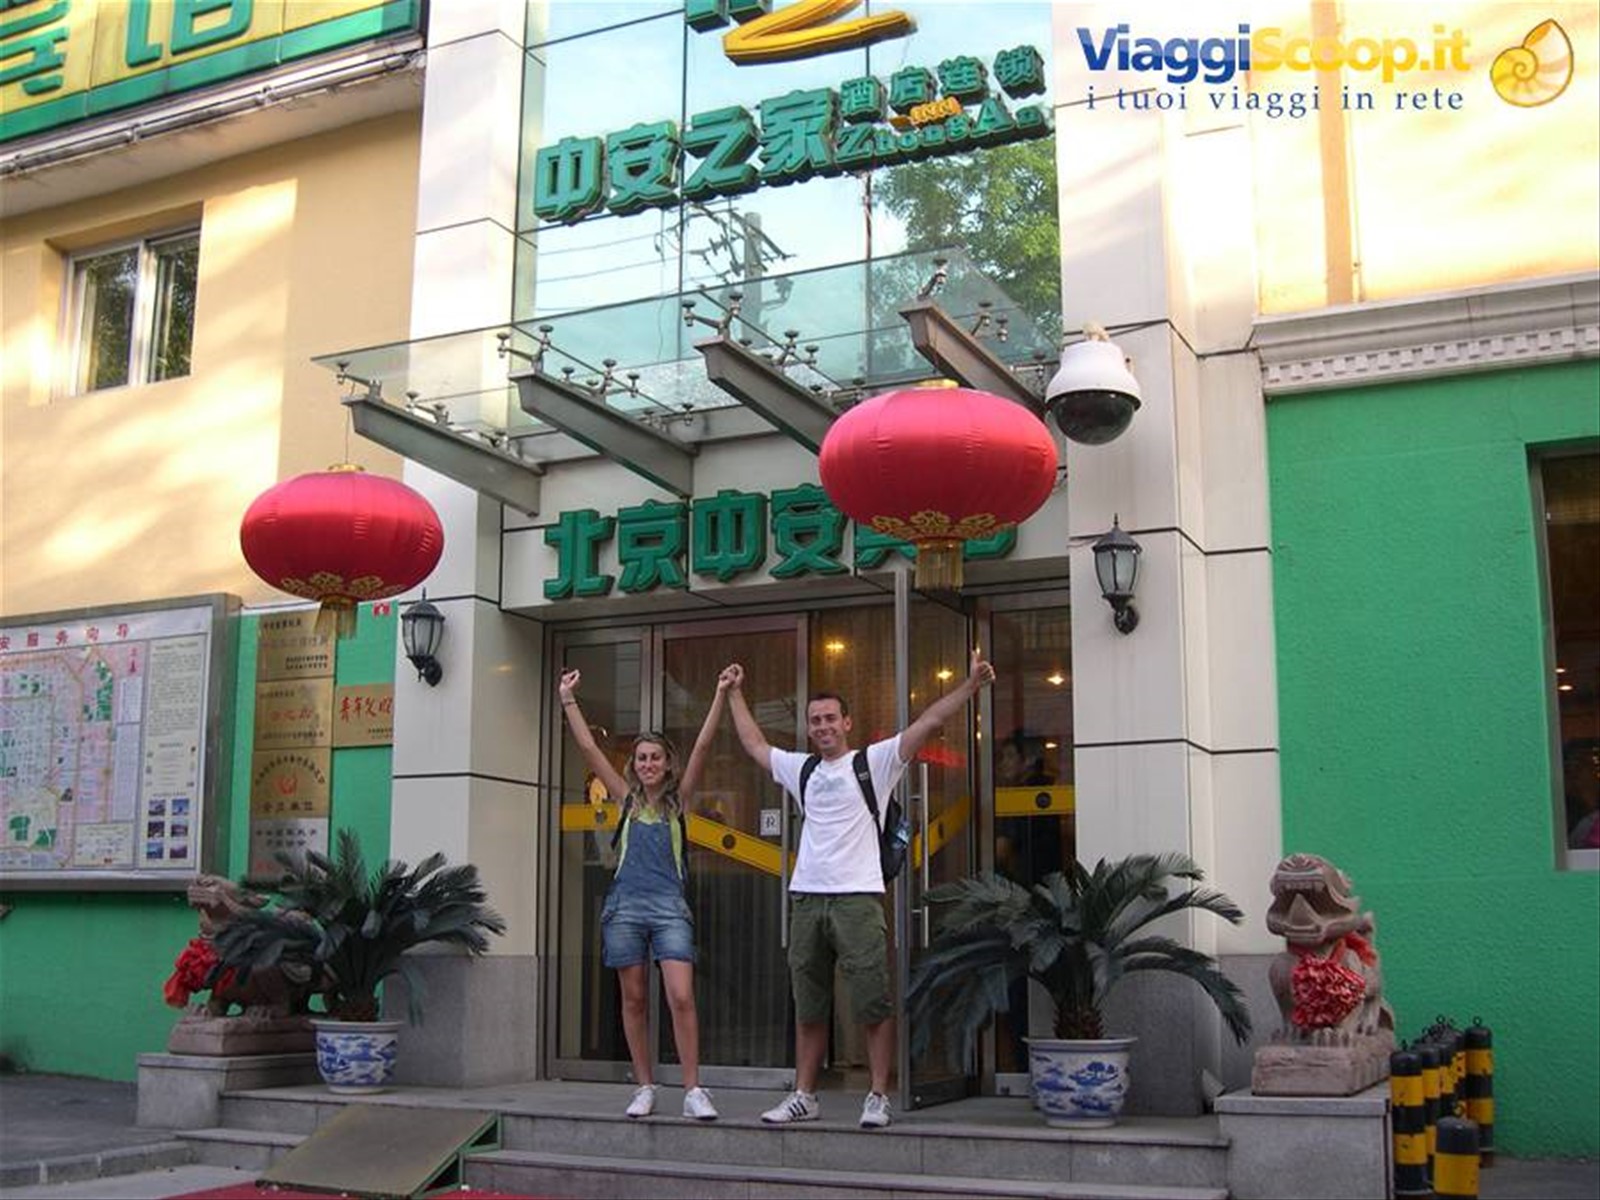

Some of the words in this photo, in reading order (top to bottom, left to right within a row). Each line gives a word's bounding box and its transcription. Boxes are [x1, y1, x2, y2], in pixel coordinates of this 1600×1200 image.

[840, 45, 1046, 122] 酒店连锁
[534, 89, 838, 223] 中安之家
[543, 483, 1016, 600] 北京中安
